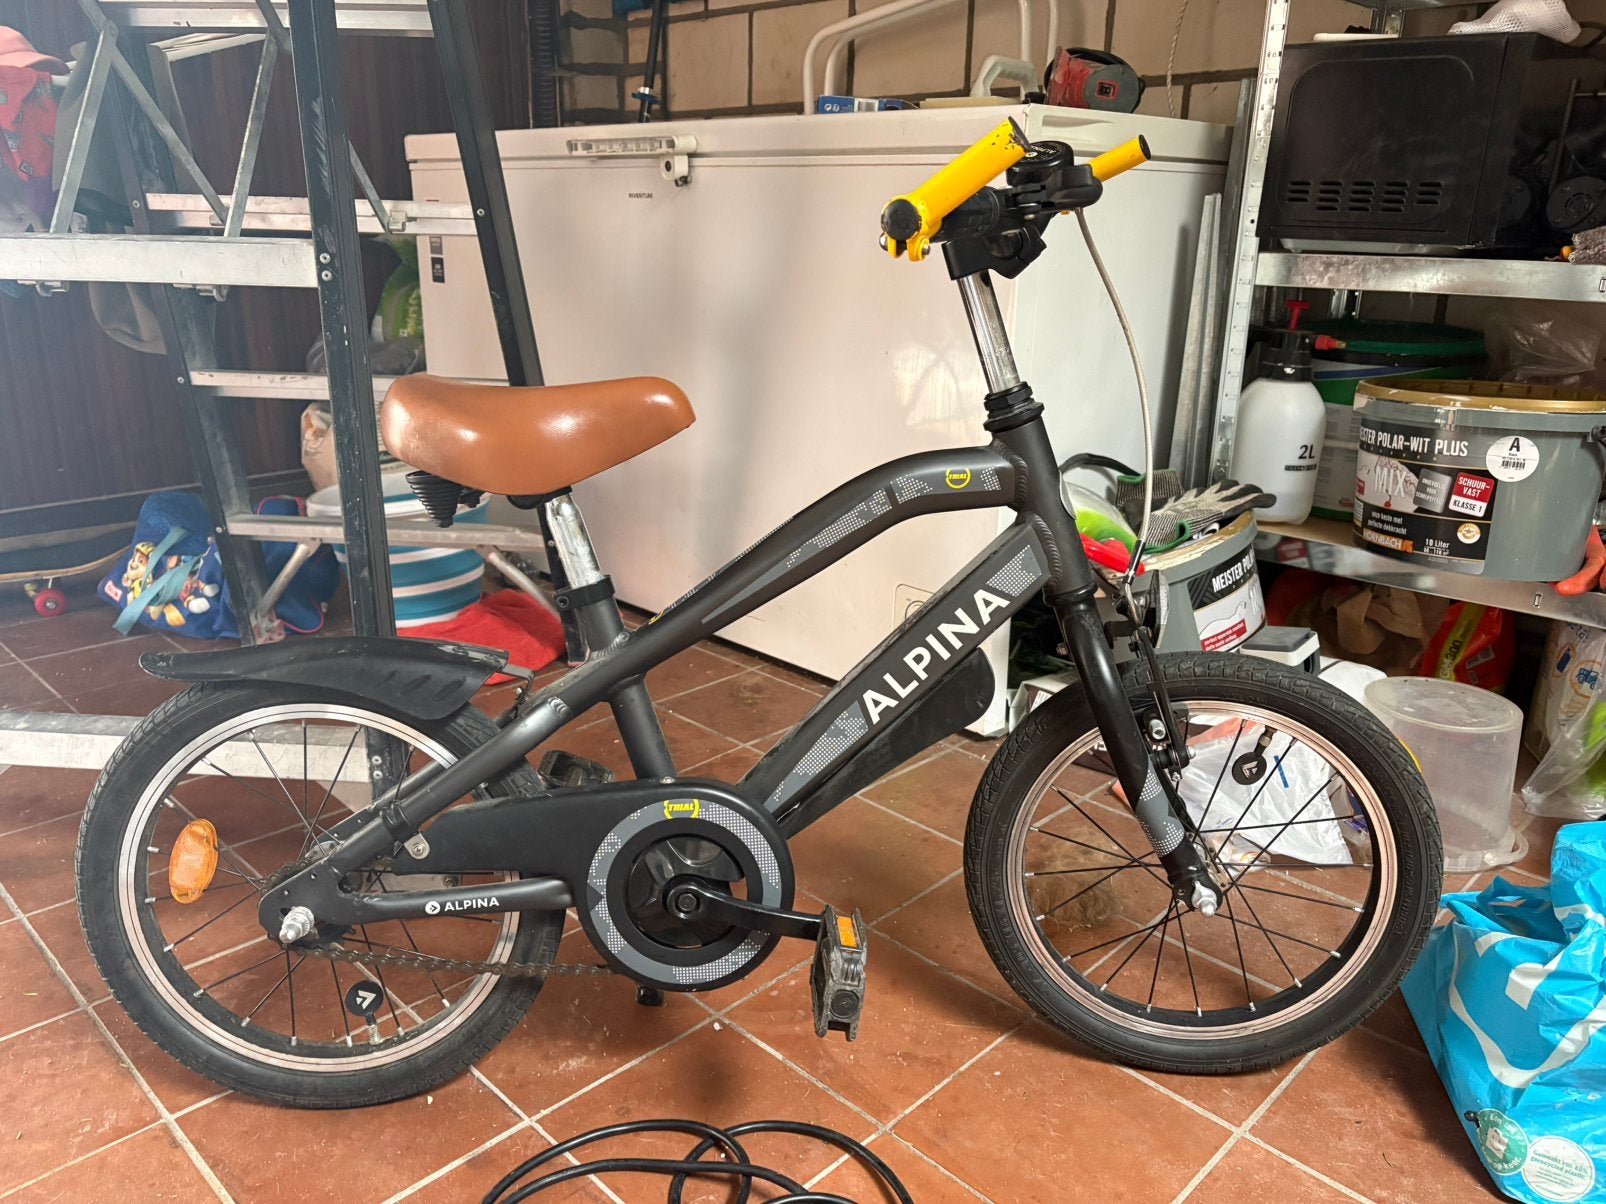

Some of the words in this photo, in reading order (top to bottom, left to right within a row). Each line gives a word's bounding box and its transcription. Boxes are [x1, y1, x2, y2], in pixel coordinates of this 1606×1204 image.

[1298, 444, 1316, 460] 2L
[1377, 431, 1431, 454] POLAR-WIT
[1434, 439, 1469, 457] PLUS
[1509, 437, 1520, 452] A
[1375, 466, 1407, 498] MIX
[1458, 476, 1491, 491] SCHUUR-
[1463, 486, 1482, 498] VAST
[1452, 499, 1477, 511] KLASSE
[1478, 505, 1483, 513] 1
[1363, 528, 1403, 550] HORNBACH
[1434, 539, 1450, 550] Liter
[1212, 562, 1244, 593] MEISTER
[862, 588, 1011, 725] ALPINA
[668, 803, 695, 812] TRIAL
[444, 896, 500, 912] ALPINA
